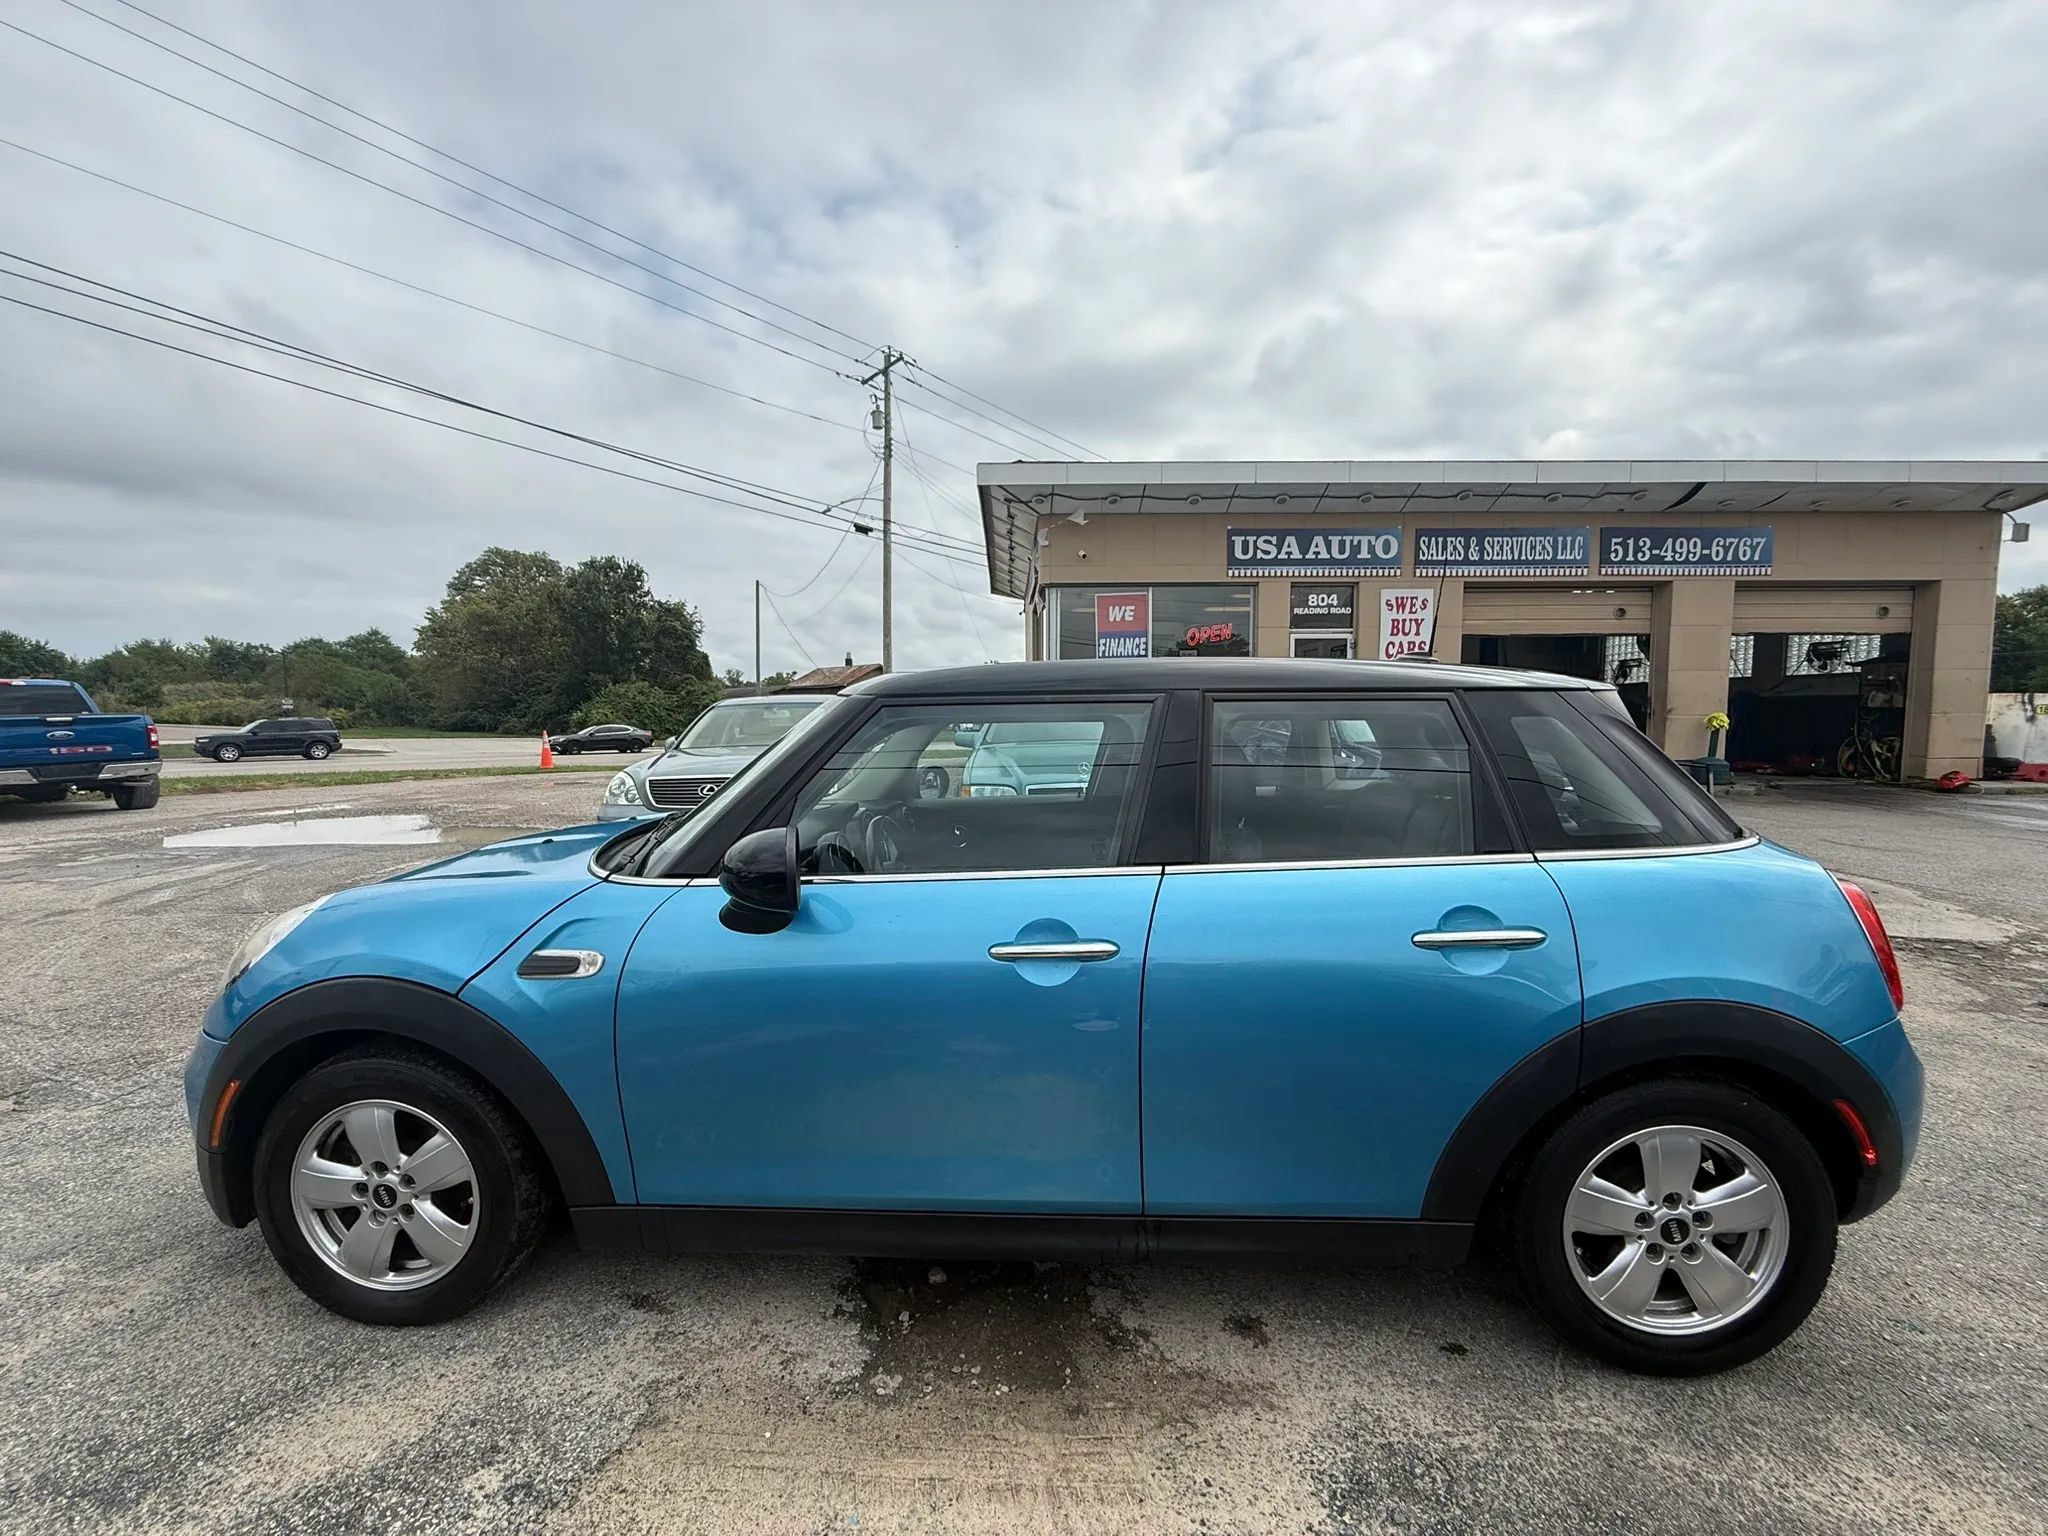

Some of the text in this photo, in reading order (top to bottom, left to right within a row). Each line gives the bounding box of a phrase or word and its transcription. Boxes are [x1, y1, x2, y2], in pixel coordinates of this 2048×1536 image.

[1232, 534, 1399, 560] USA AUTO
[1419, 536, 1584, 561] SALES & SERVICES LLC
[1609, 537, 1767, 562] 513-499-6767
[1308, 594, 1338, 606] 804
[1108, 605, 1136, 622] WE
[1293, 607, 1329, 615] READING
[1186, 623, 1233, 646] OPEN
[1390, 618, 1425, 637] BUY
[1099, 637, 1147, 657] FINANCE
[377, 1185, 392, 1206] MINI
[1668, 1220, 1682, 1242] MINI
